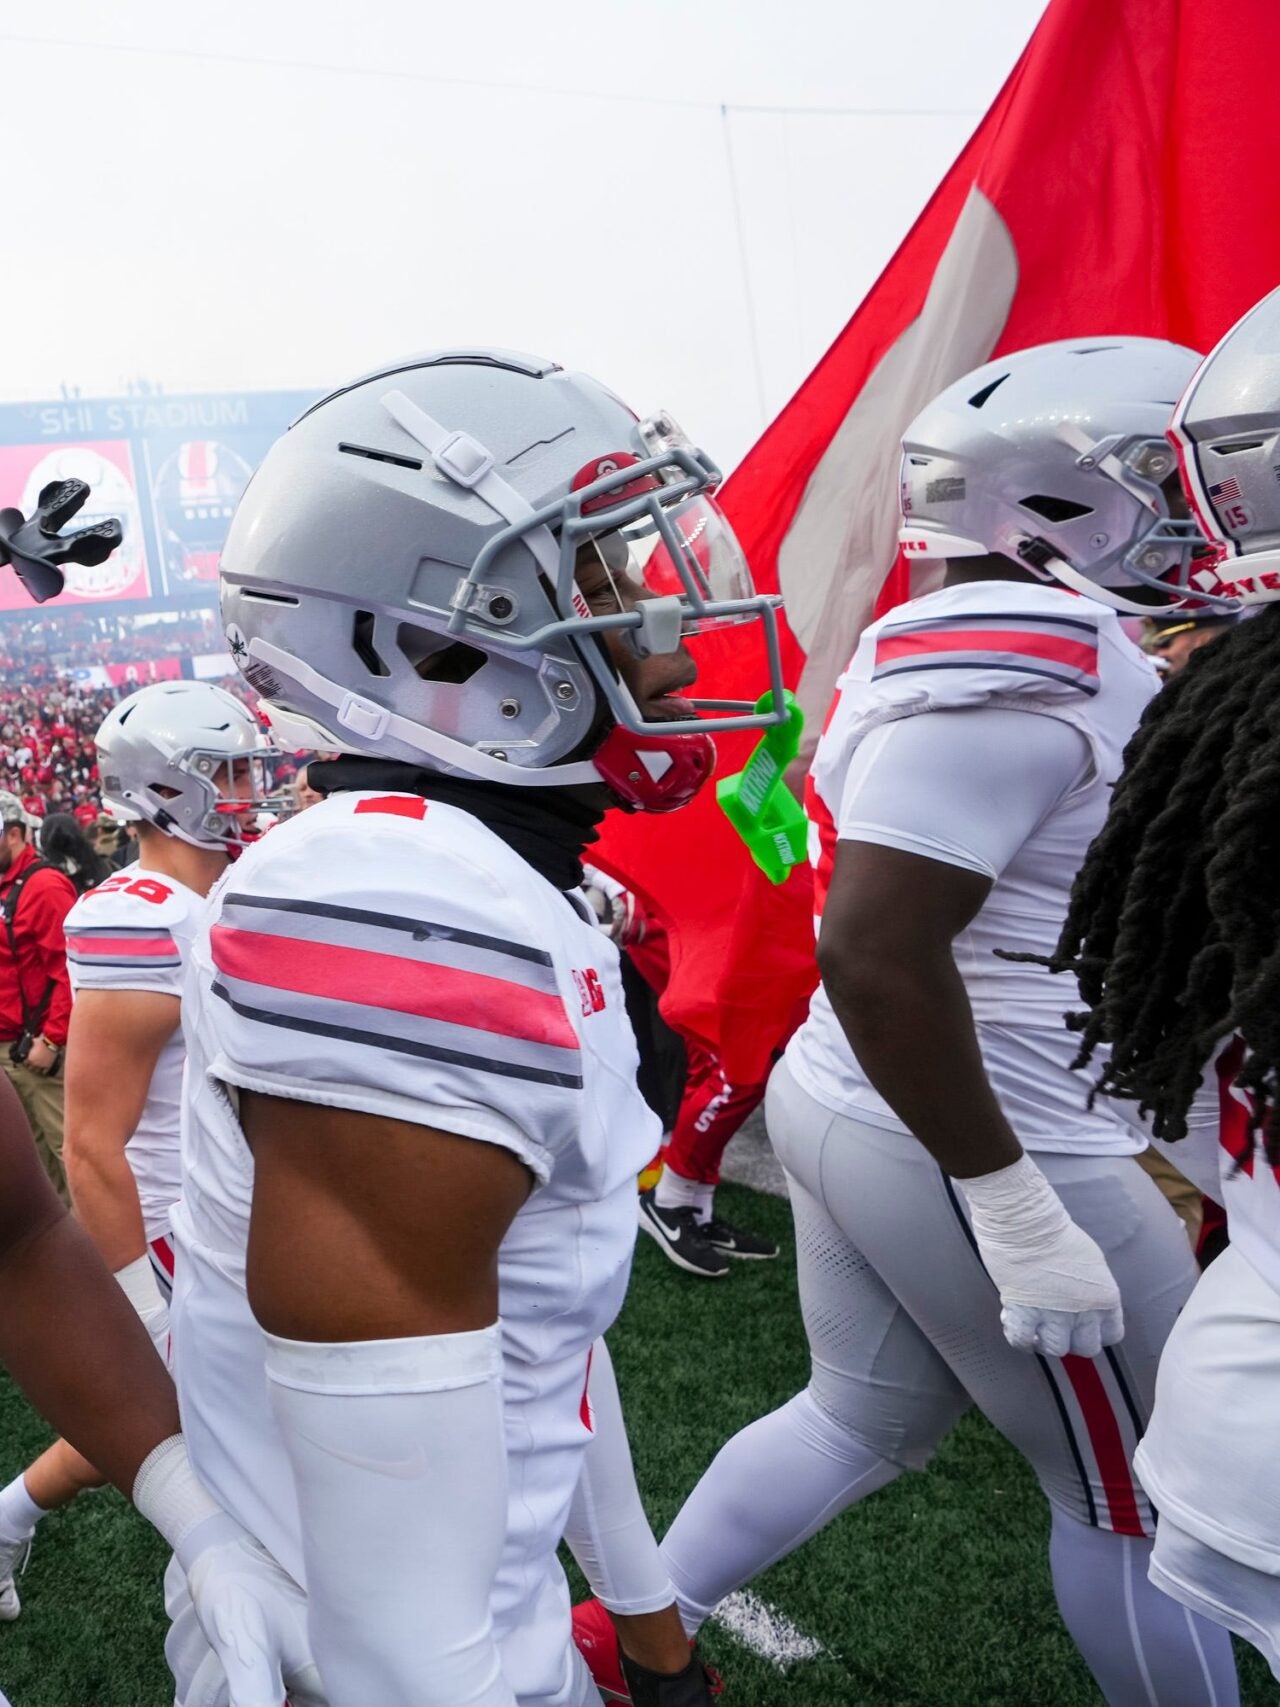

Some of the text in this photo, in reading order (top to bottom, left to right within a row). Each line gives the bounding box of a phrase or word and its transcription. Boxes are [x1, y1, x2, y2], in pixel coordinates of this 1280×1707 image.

[40, 399, 249, 435] SHI STADIUM
[1224, 505, 1249, 529] 15
